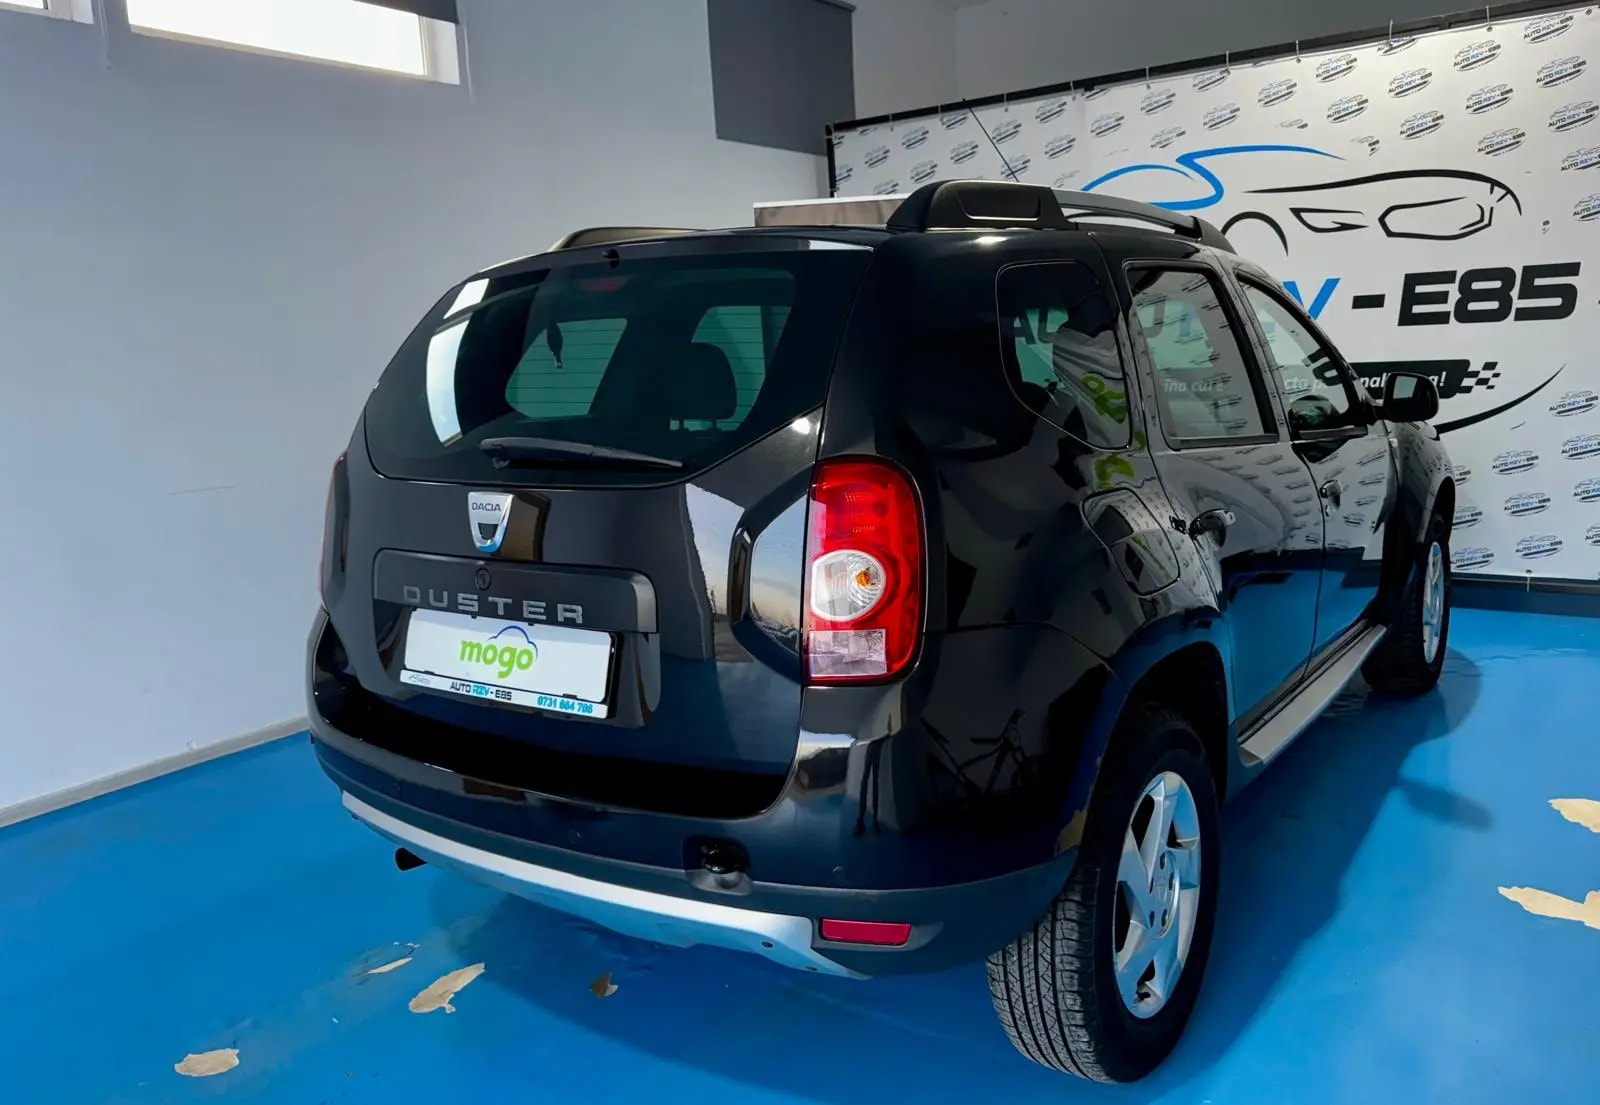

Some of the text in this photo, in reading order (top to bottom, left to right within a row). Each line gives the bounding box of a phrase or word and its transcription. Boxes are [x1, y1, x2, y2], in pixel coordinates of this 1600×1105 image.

[1397, 262, 1581, 326] E85
[471, 501, 502, 513] DACIA
[403, 585, 583, 624] DUSTER
[459, 638, 533, 679] mogo
[450, 680, 471, 693] AUTO
[495, 689, 512, 701] E85
